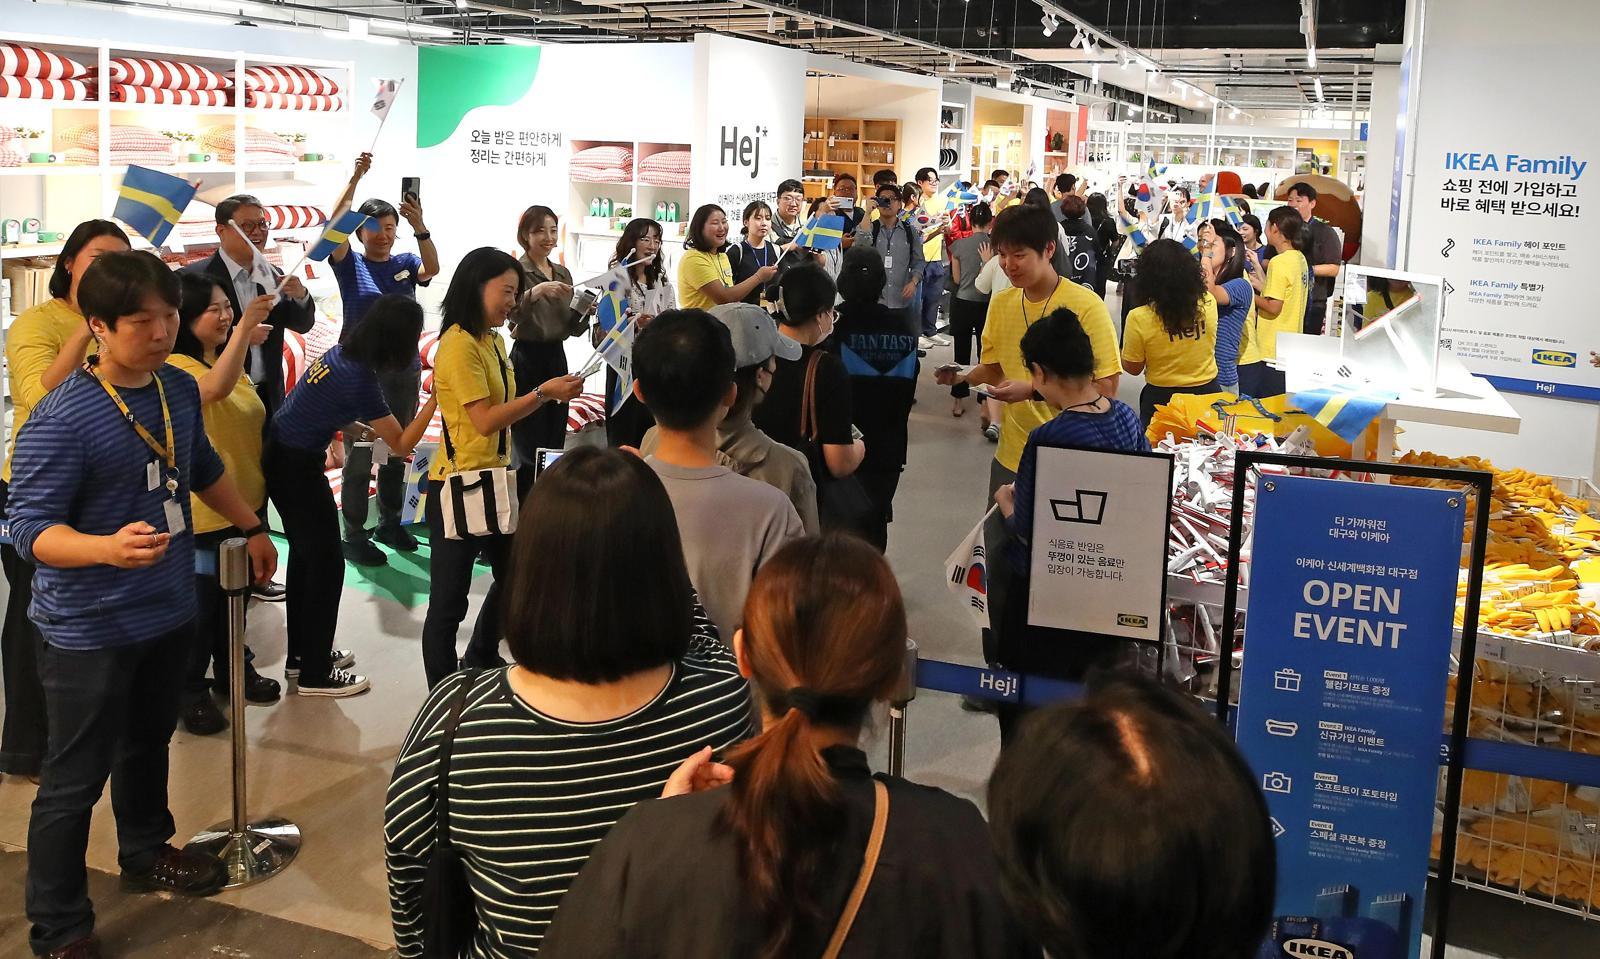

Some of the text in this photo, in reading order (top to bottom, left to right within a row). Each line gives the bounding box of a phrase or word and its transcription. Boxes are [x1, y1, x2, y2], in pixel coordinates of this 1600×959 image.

[471, 130, 562, 148] 오늘 밤은 편안하게
[470, 149, 546, 166] 정리는 간편하게
[1445, 152, 1588, 180] IKEA Family
[1442, 178, 1577, 198] 쇼핑 전에 가입하고
[1440, 197, 1580, 218] 바로 혜택 받으세요!
[1494, 240, 1522, 250] Family
[1542, 242, 1566, 250] 포인트
[1470, 280, 1544, 292] IKEA Family 특별가
[848, 334, 914, 351] FANTASY
[1536, 354, 1572, 363] IKEA
[1536, 383, 1556, 394] Hej!
[1335, 516, 1386, 531] 더 가까워진
[1329, 528, 1390, 544] 대구와 이케아
[1048, 539, 1104, 554] 식음료 반입은
[1048, 552, 1125, 568] 뚜껑이 있는 음료만
[1048, 564, 1124, 582] 입장이 가능합니다.
[1296, 558, 1418, 580] 이케아 신세계백화점 대구점
[1303, 580, 1400, 614] OPEN
[1294, 612, 1408, 648] EVENT
[980, 672, 1017, 696] Hej!
[1325, 680, 1370, 693] 웰컴기프트
[1372, 685, 1390, 696] 증정
[1320, 730, 1356, 744] 신규가입
[1358, 734, 1385, 746] 이벤트
[1344, 726, 1358, 734] IKEA
[1358, 728, 1376, 736] Family
[1314, 782, 1360, 796] 소프트토이
[1362, 788, 1398, 802] 포토타임
[1310, 830, 1337, 842] 스페셜
[1340, 834, 1366, 846] 쿠폰북
[1368, 838, 1386, 850] 증정
[1289, 942, 1347, 959] IKEA
